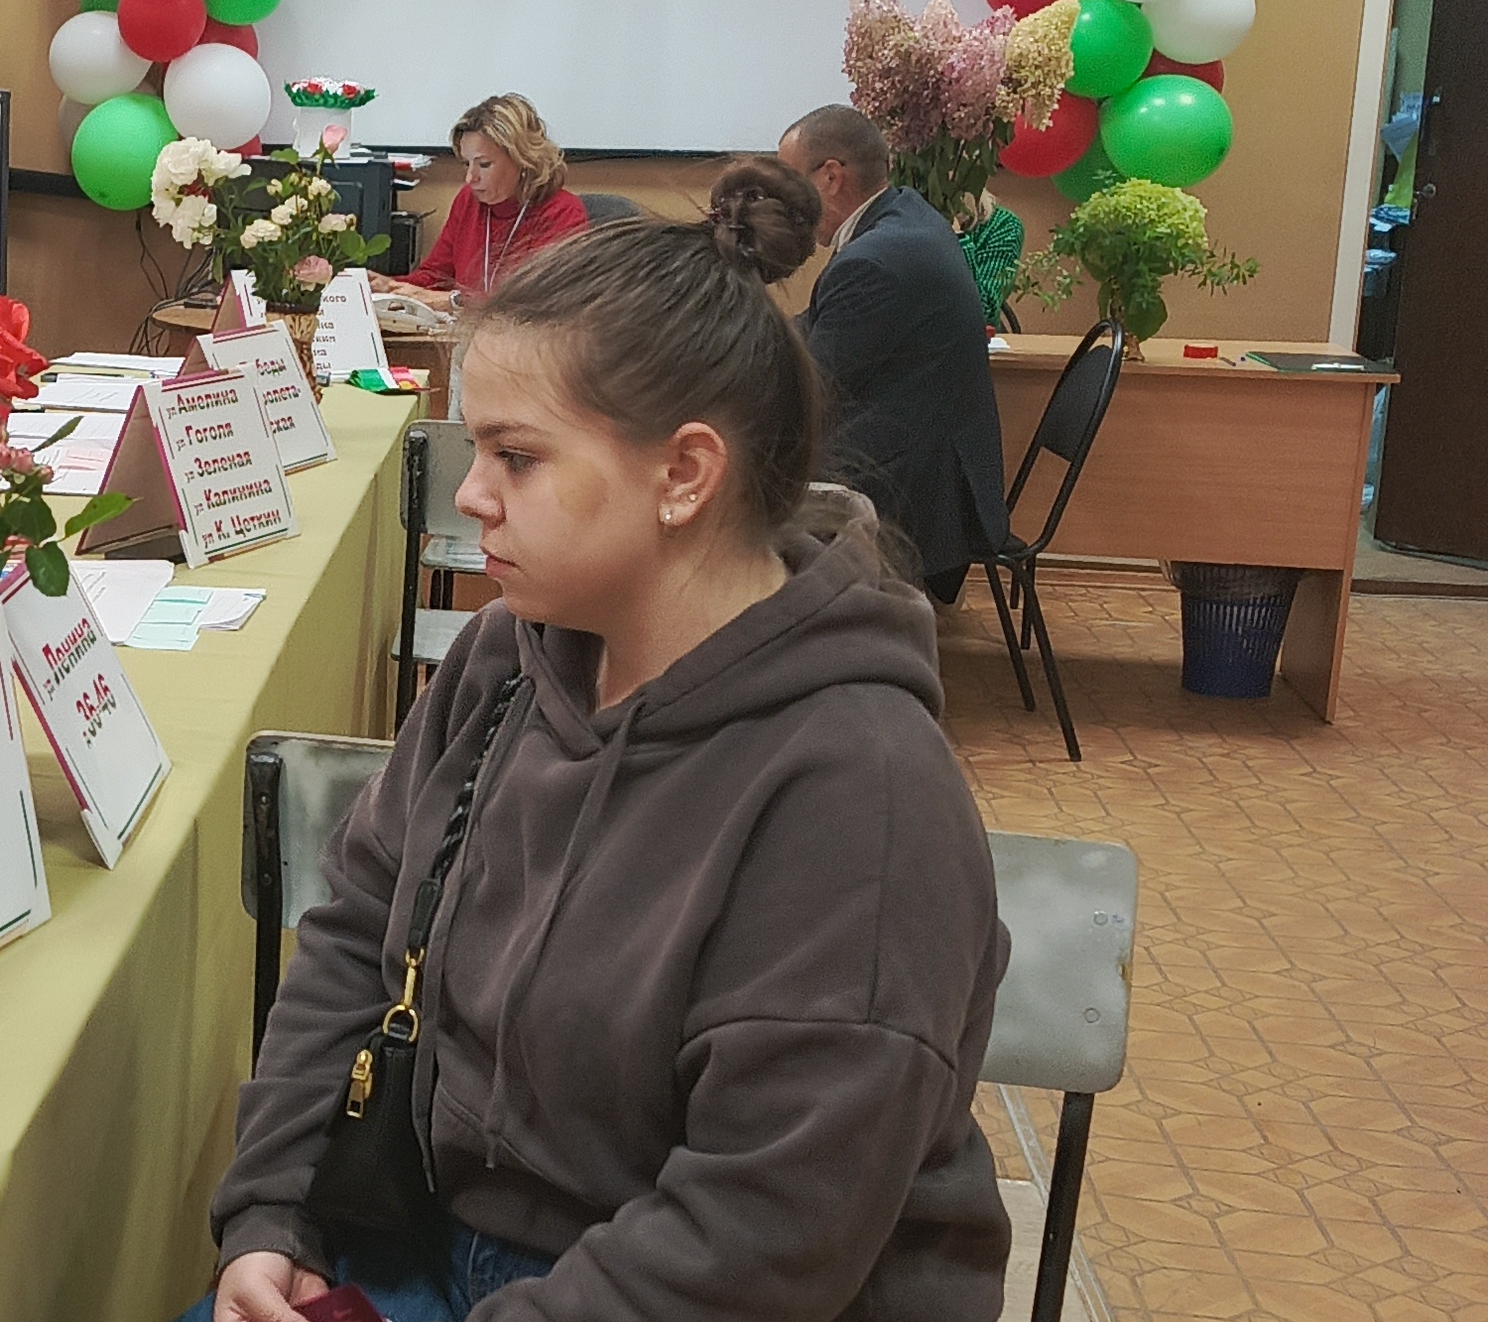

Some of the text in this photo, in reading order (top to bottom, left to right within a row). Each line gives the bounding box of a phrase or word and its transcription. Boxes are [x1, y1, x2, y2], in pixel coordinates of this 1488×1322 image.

[255, 357, 287, 377] беды
[176, 388, 239, 416] Амелина
[185, 421, 234, 446] Гоголя
[193, 450, 252, 477] Зеленая
[203, 478, 272, 510] Калинина
[230, 508, 282, 538] Цеткин
[42, 617, 97, 686] Ленина
